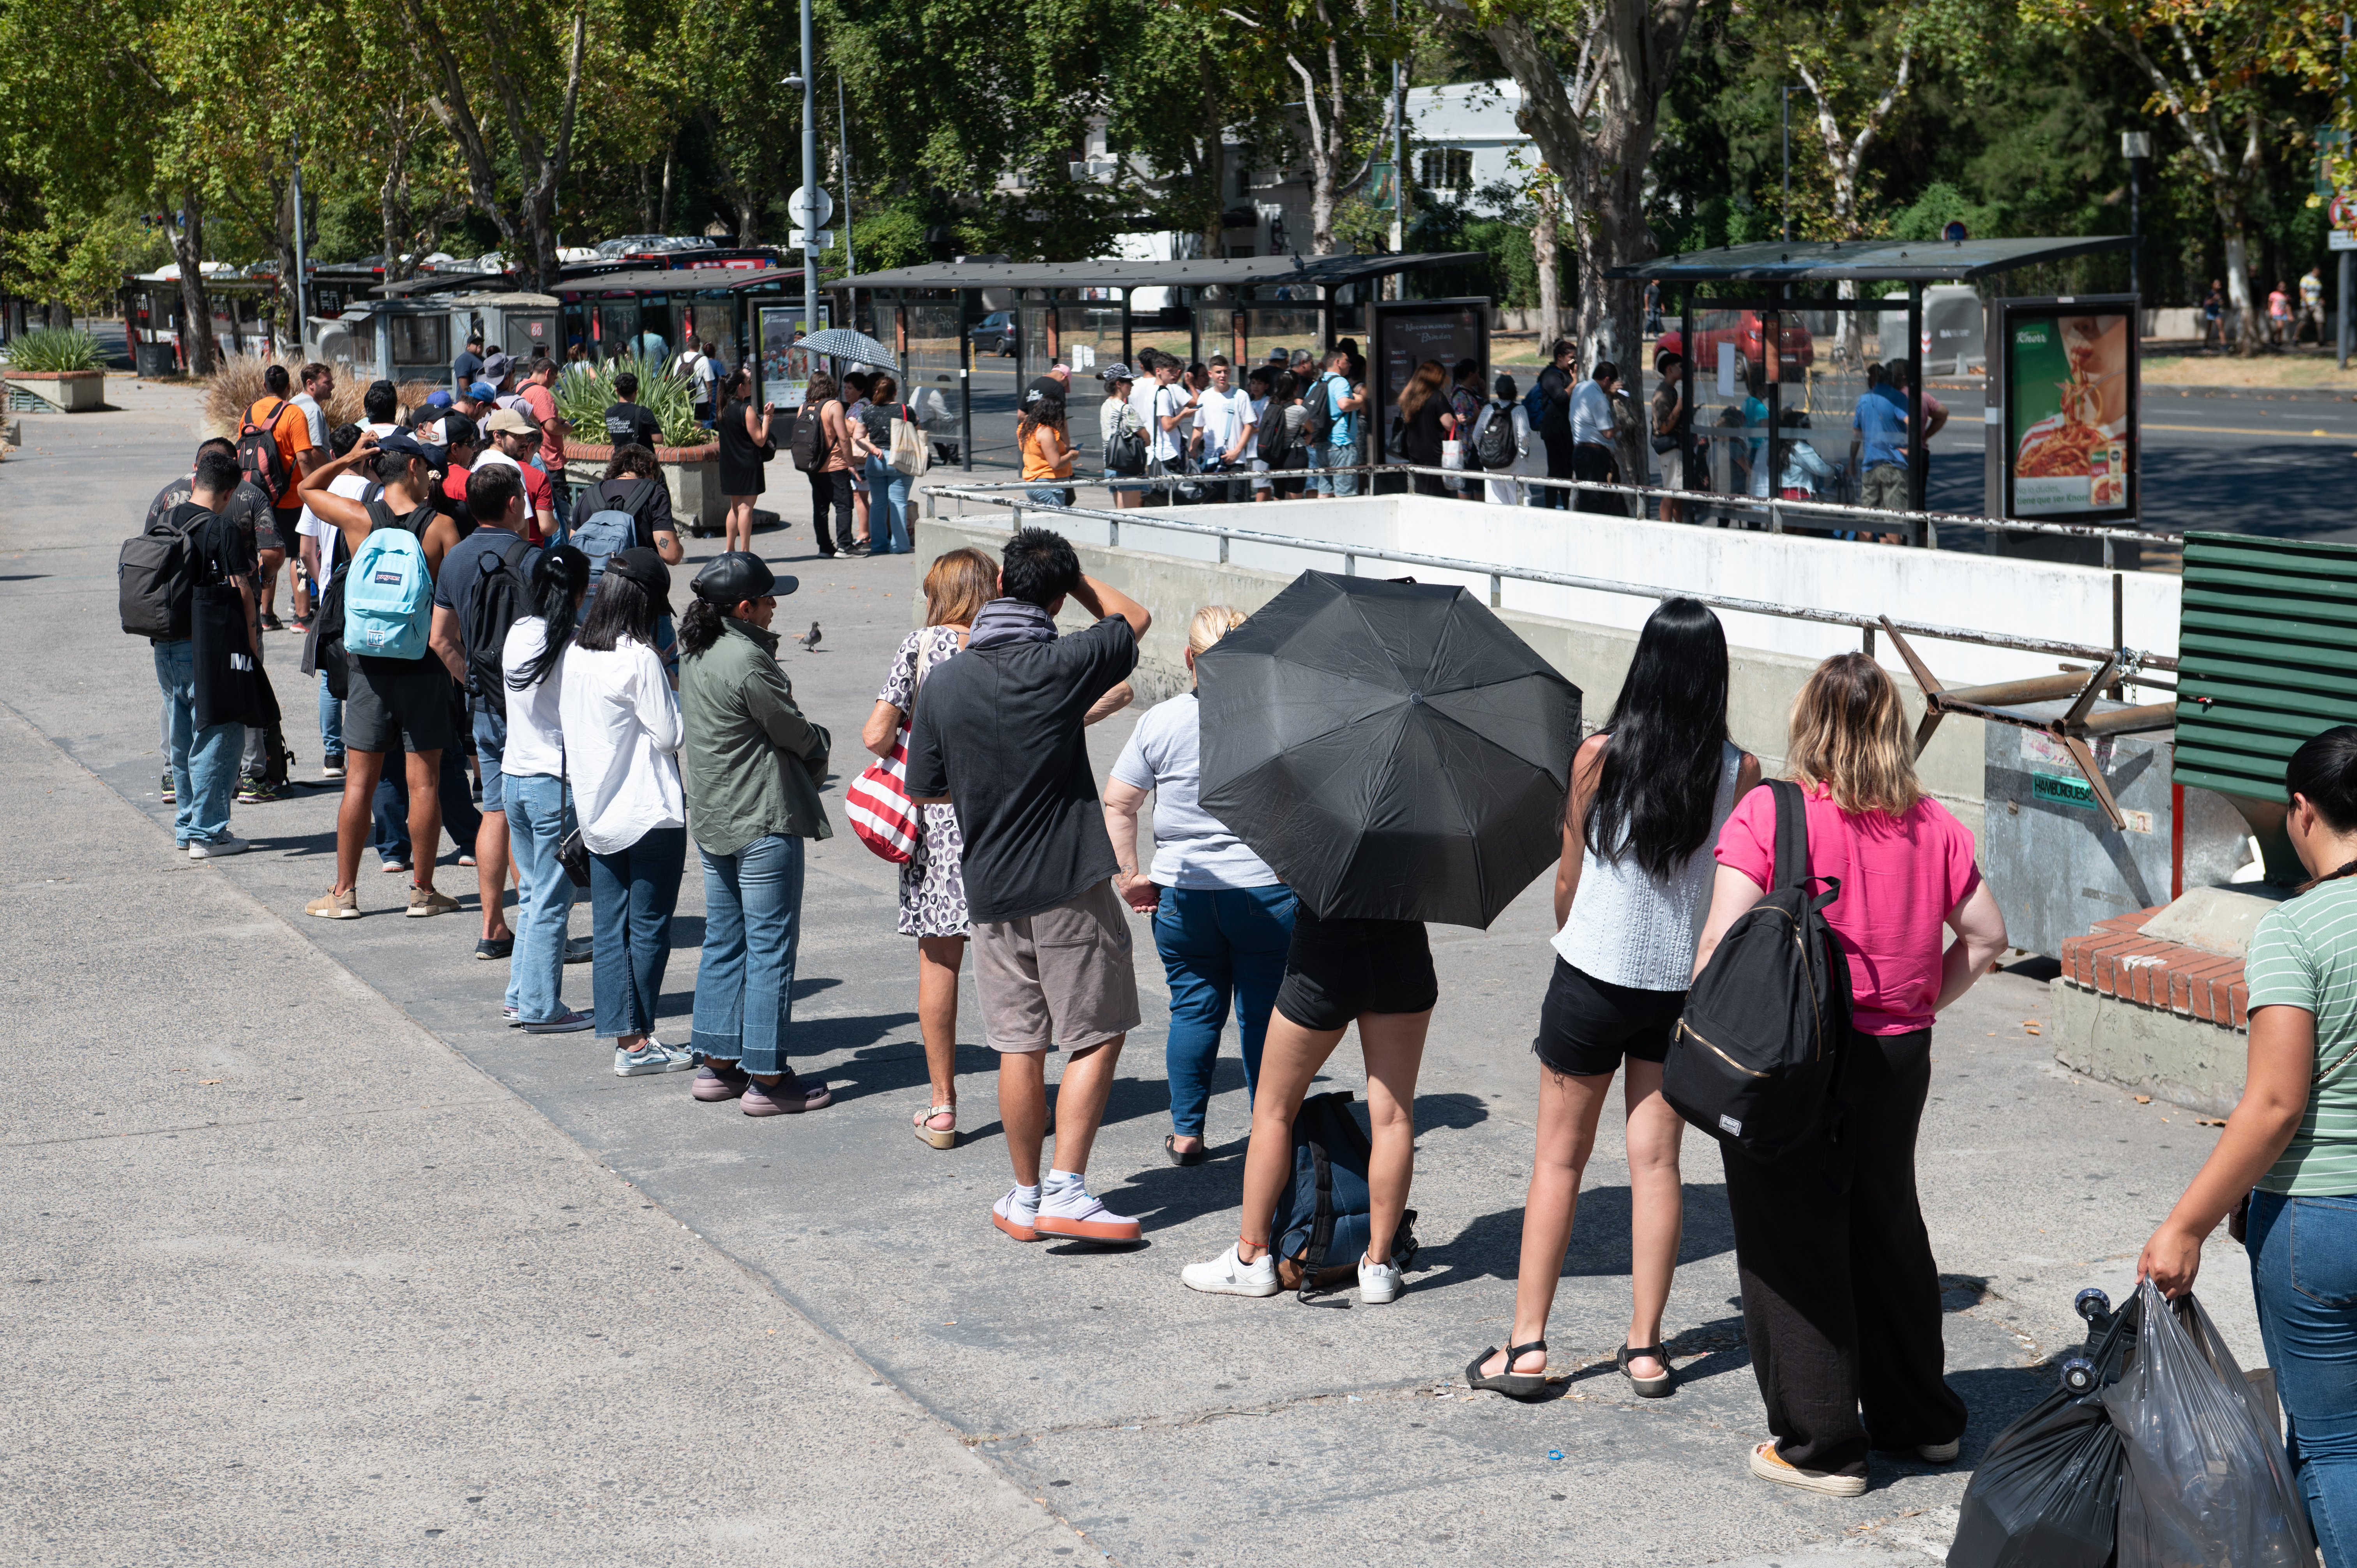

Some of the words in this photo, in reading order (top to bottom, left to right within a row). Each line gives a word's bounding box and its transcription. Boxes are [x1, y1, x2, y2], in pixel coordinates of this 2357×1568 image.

[532, 326, 542, 336] 60
[2016, 331, 2047, 343] Knorr
[2017, 496, 2035, 505] tiene
[2037, 496, 2051, 507] que
[2066, 493, 2088, 502] Knorr
